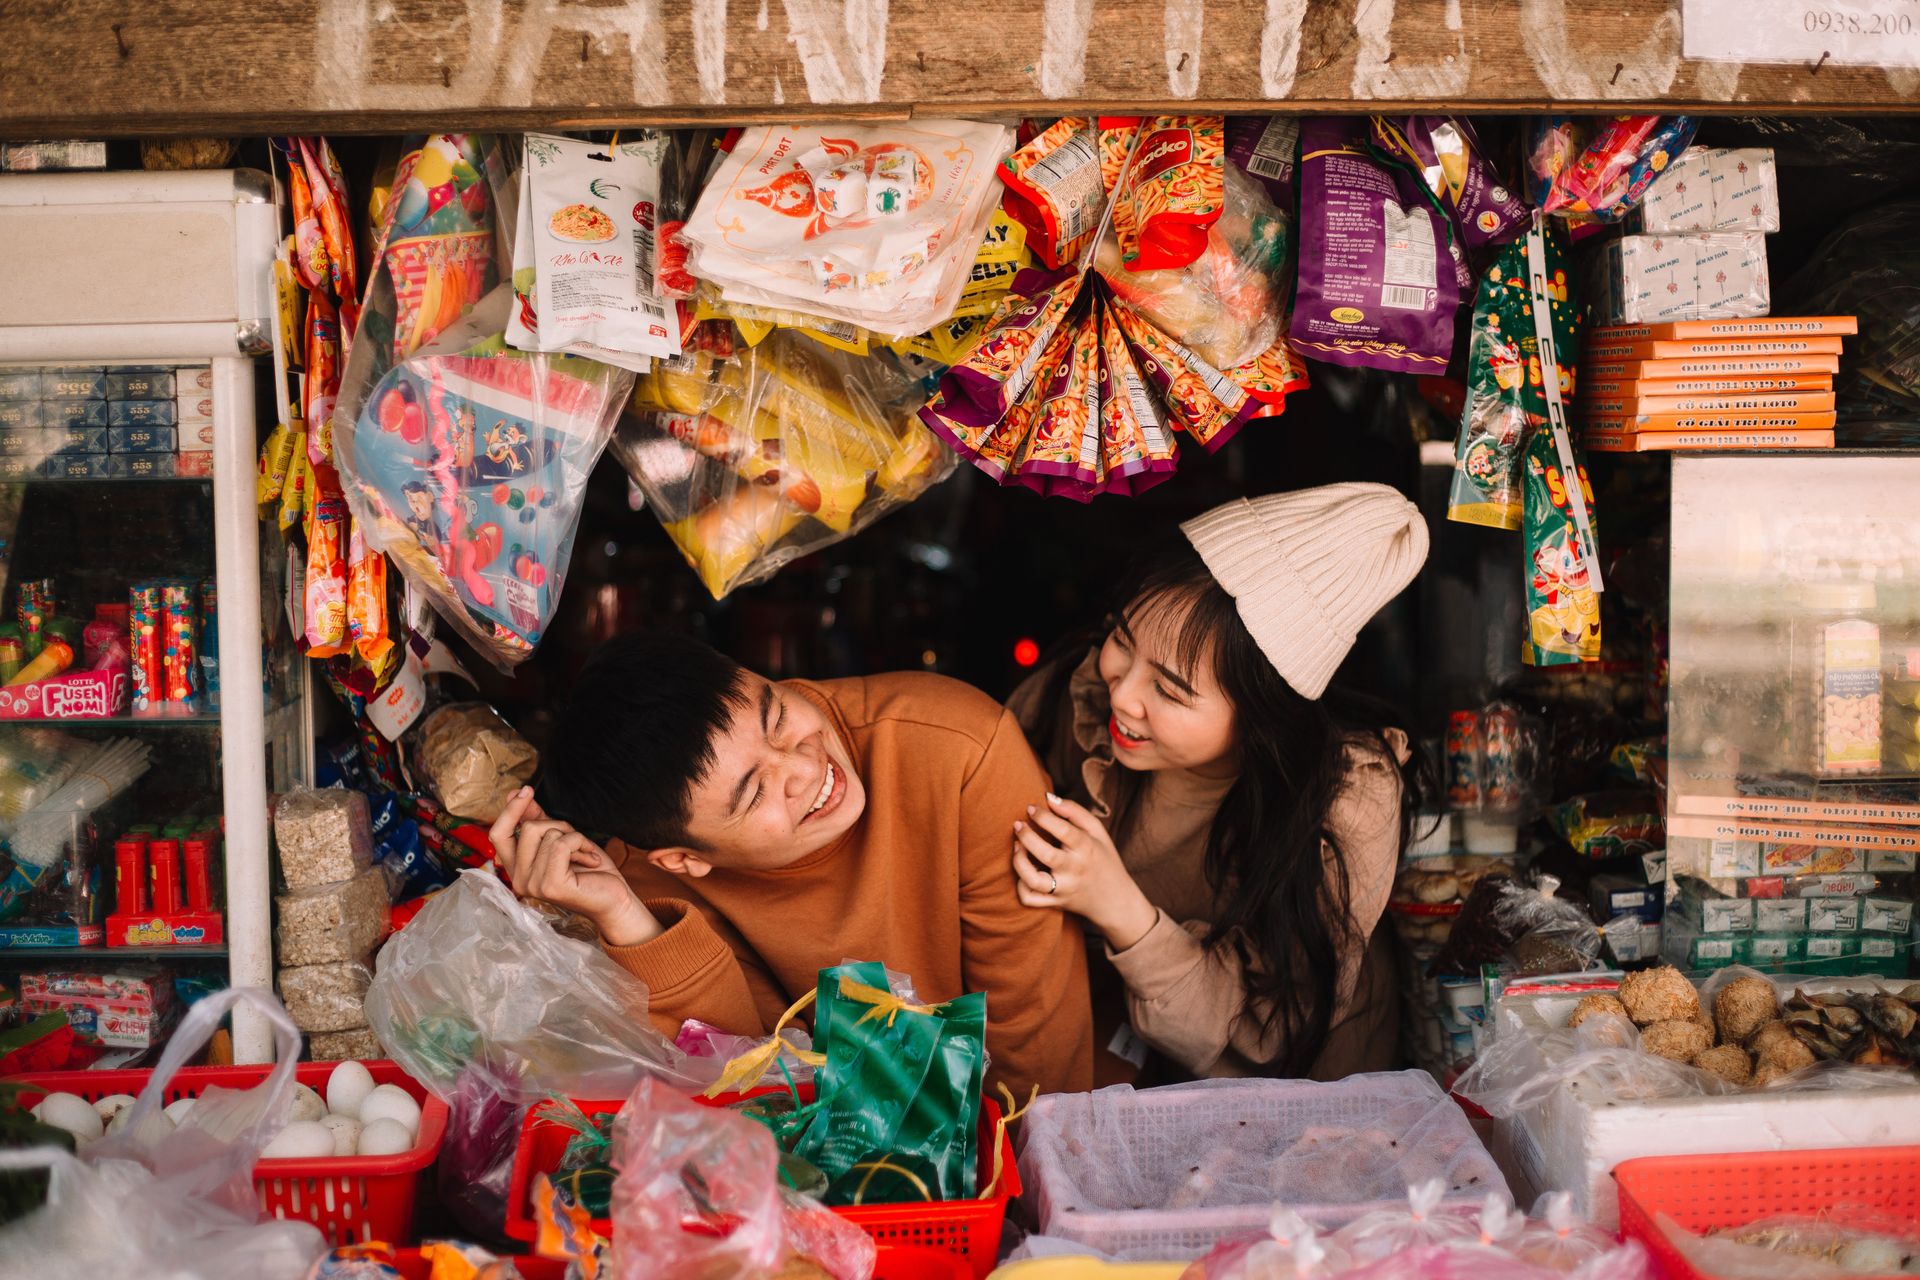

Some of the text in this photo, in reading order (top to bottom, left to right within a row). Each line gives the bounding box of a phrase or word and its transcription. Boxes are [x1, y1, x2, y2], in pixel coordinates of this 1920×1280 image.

[1711, 324, 1744, 333] LOTO
[1692, 345, 1726, 353] LOTO
[1681, 364, 1717, 372] LOTO
[1762, 400, 1798, 408] LOTO
[129, 407, 151, 415] 555
[1761, 418, 1797, 426] LOTO
[130, 433, 151, 441] 555
[132, 462, 152, 471] 555
[68, 678, 95, 686] LOTTE
[62, 700, 103, 714] NOMI
[1823, 806, 1858, 817] LOTO
[1814, 832, 1851, 844] LOTO
